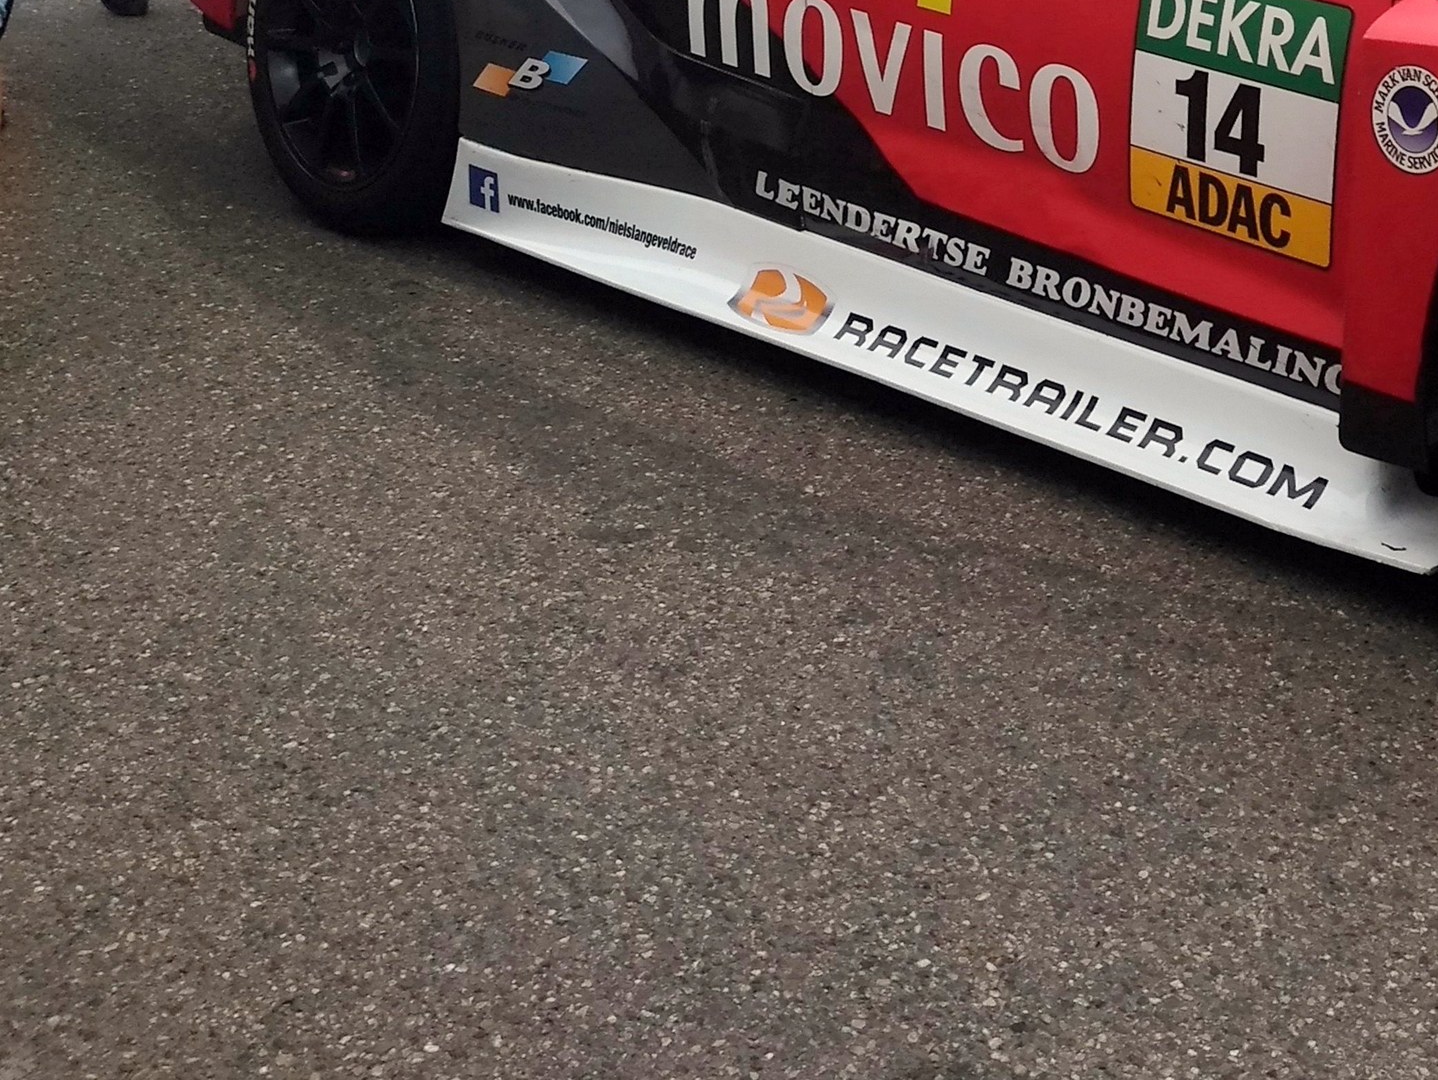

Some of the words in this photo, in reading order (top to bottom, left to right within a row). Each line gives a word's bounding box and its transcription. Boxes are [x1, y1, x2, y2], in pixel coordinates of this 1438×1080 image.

[508, 57, 551, 90] B
[1374, 72, 1400, 113] MARK
[1397, 68, 1422, 82] VAN
[1175, 69, 1265, 178] 14
[1375, 121, 1407, 167] MARINE
[507, 192, 697, 260] www.facebook.com/nielslangeveldrace
[755, 170, 991, 276] LEENDERTSE
[1166, 164, 1292, 249] ADAC
[833, 311, 1330, 510] RACETRAILER.COM
